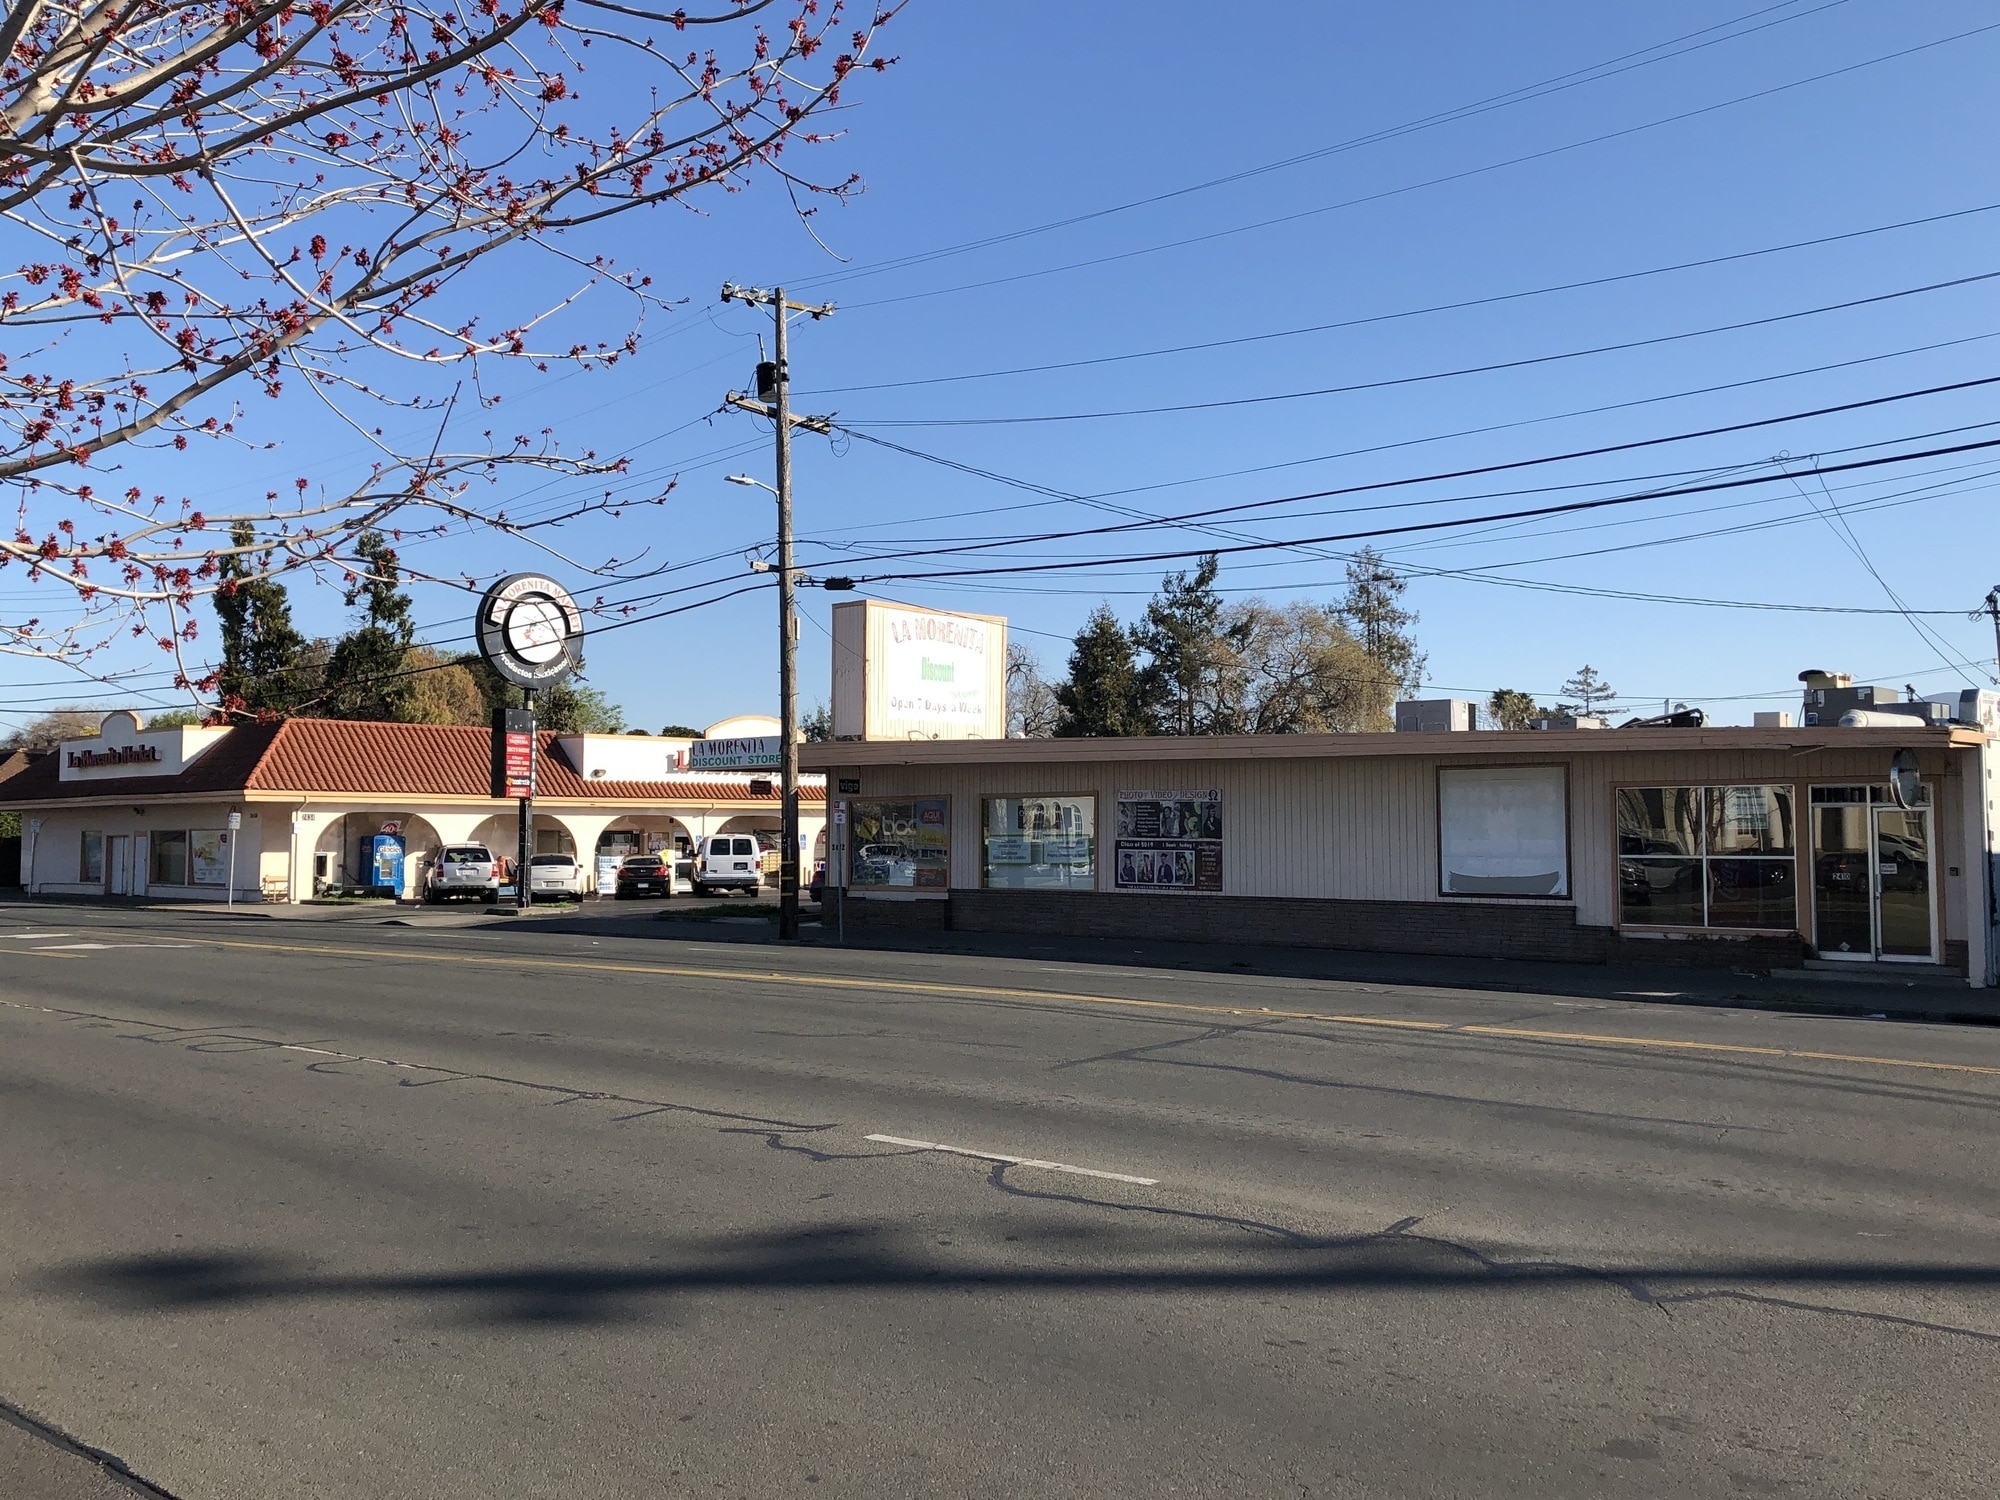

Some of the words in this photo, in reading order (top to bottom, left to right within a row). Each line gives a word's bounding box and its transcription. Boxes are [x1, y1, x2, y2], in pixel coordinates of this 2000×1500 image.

[891, 619, 912, 644] LA
[915, 618, 984, 654] MORENITA
[921, 656, 955, 683] Discount
[891, 696, 914, 711] Open
[692, 742, 705, 757] LA
[708, 738, 765, 756] MORENITA
[692, 755, 743, 767] DISCOUNT
[748, 754, 781, 765] STORE
[840, 780, 859, 792] vigo
[1150, 791, 1173, 799] VIDEO
[1180, 791, 1208, 799] DESIGN
